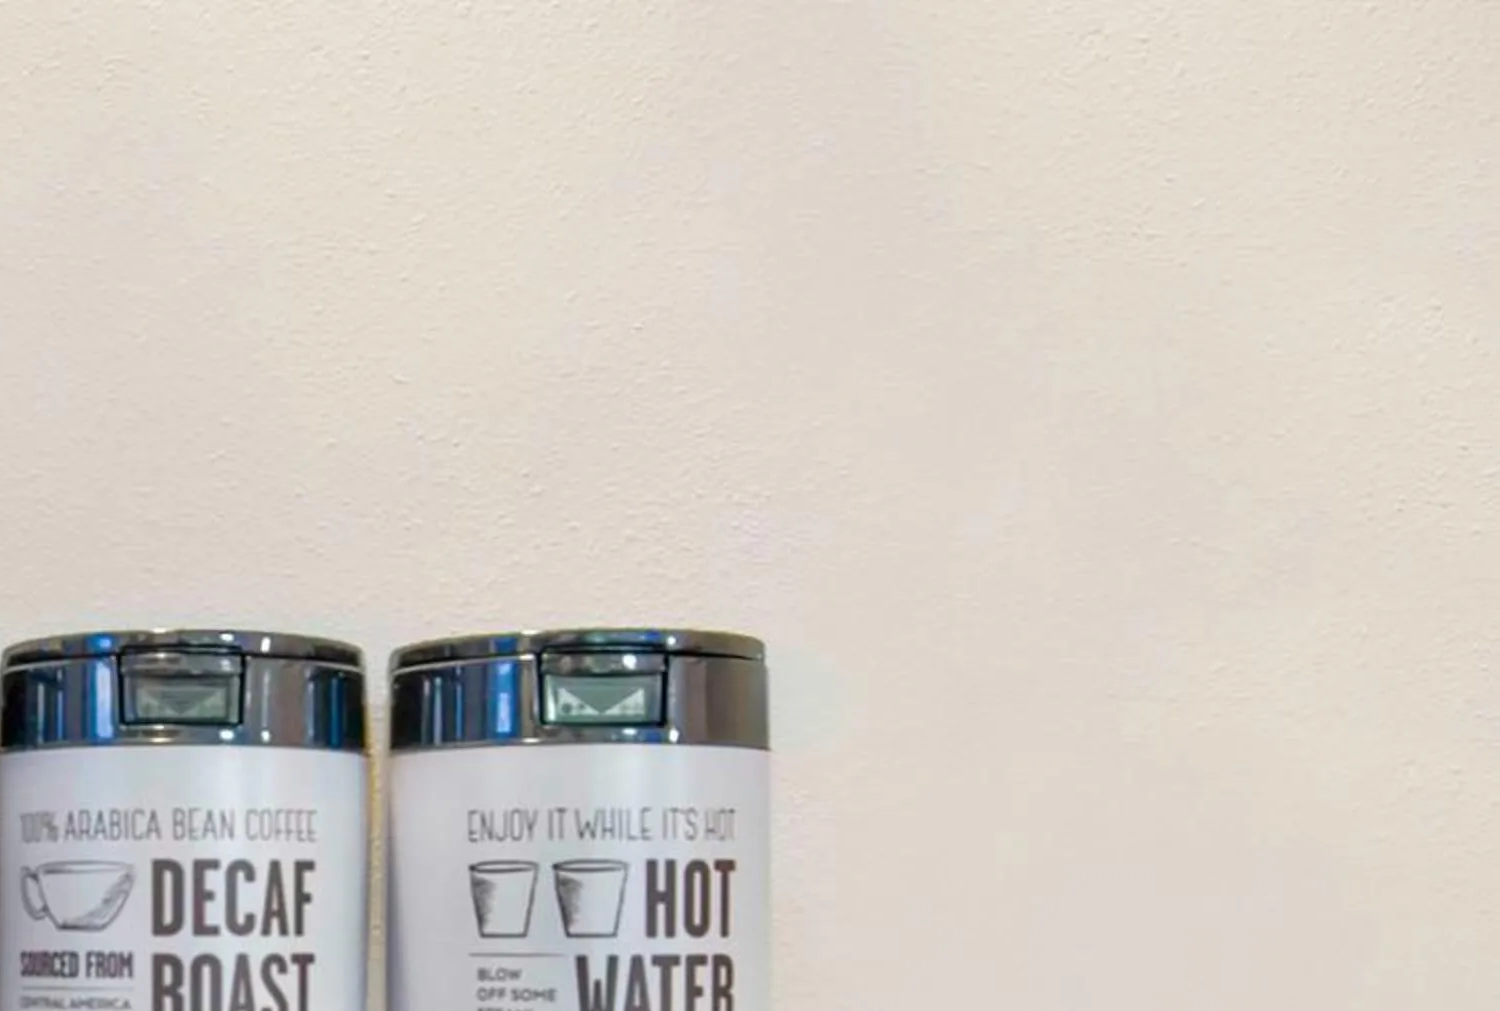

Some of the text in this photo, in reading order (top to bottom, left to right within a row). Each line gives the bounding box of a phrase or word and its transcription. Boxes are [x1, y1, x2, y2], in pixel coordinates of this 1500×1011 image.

[64, 808, 161, 841] ARABICA
[172, 807, 235, 841] BEAN
[245, 809, 318, 843] COFFEE
[468, 808, 538, 842] ENJOY
[548, 808, 566, 841] IT
[575, 807, 652, 841] WHILE
[704, 807, 736, 841] HOT
[151, 859, 316, 937] DECAF
[646, 859, 736, 938] HOT
[20, 951, 133, 979] SOURCED FROM
[477, 968, 522, 982] BLOW
[476, 989, 557, 1003] OFF SOME
